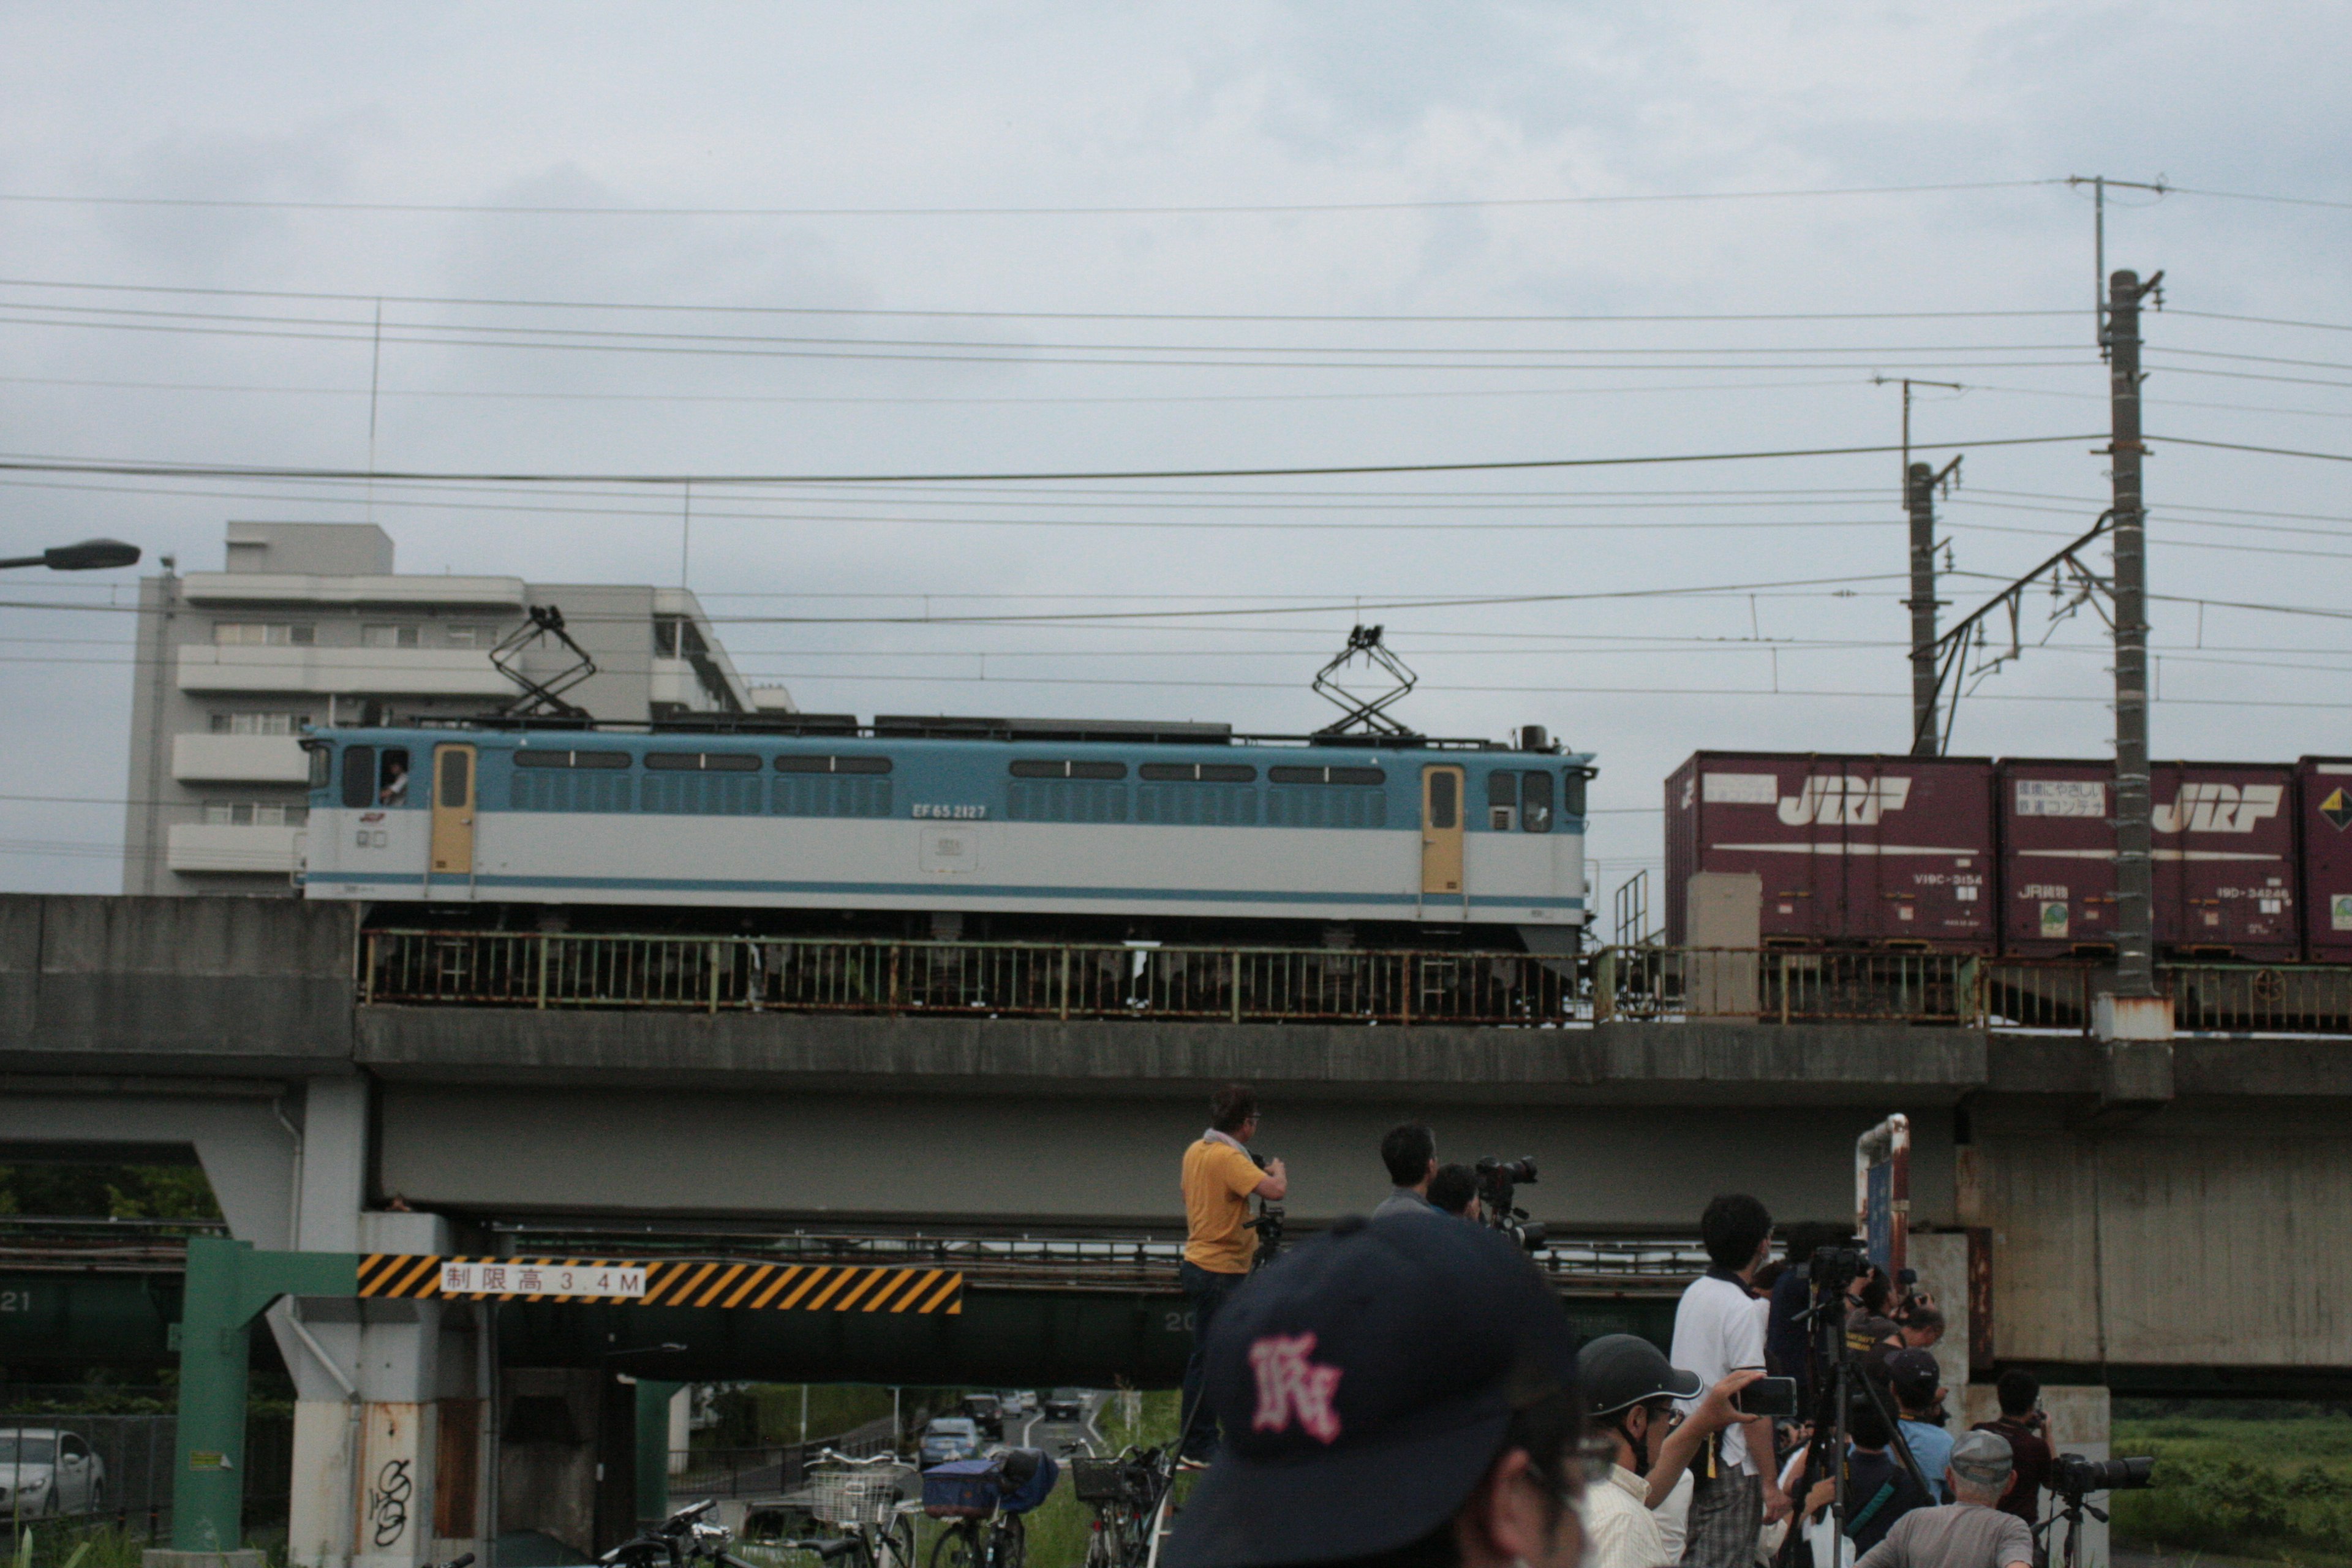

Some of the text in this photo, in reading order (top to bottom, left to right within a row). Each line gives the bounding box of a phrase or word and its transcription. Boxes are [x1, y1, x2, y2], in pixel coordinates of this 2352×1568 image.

[1777, 775, 1912, 826] JRF
[2152, 783, 2283, 833] JRF
[1, 1291, 29, 1311] 21
